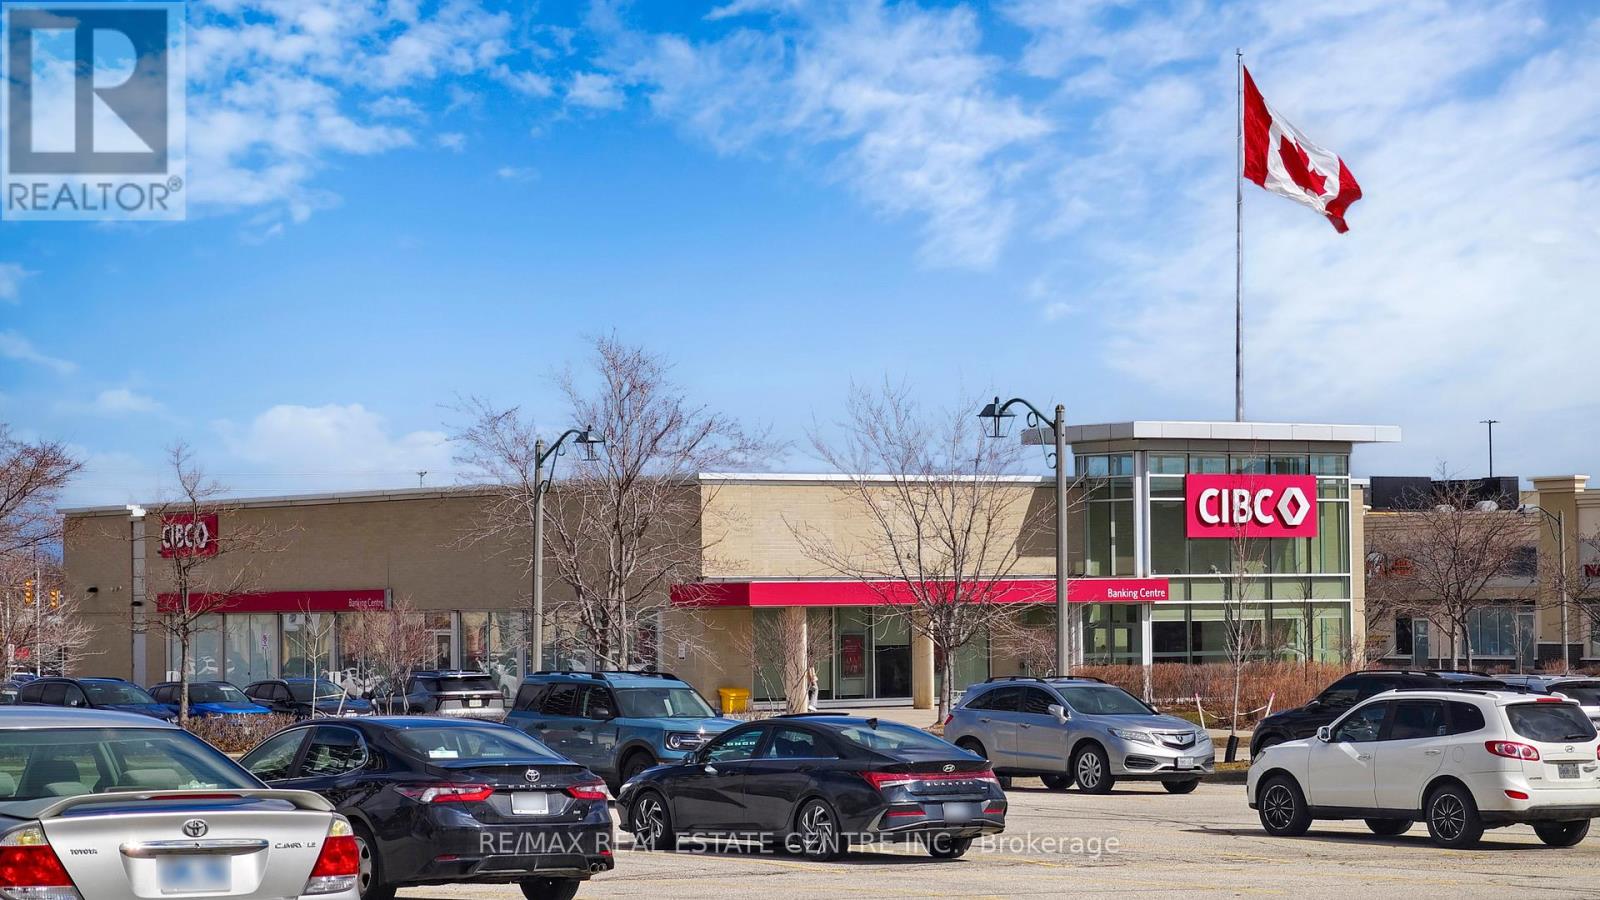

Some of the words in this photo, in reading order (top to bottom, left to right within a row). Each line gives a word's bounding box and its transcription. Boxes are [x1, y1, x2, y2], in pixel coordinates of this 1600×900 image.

[1199, 488, 1275, 524] CIBC
[162, 523, 194, 548] CIBC
[1107, 588, 1139, 600] Banking
[1139, 588, 1166, 598] Centre
[348, 598, 368, 609] Banking
[368, 598, 384, 607] Centre
